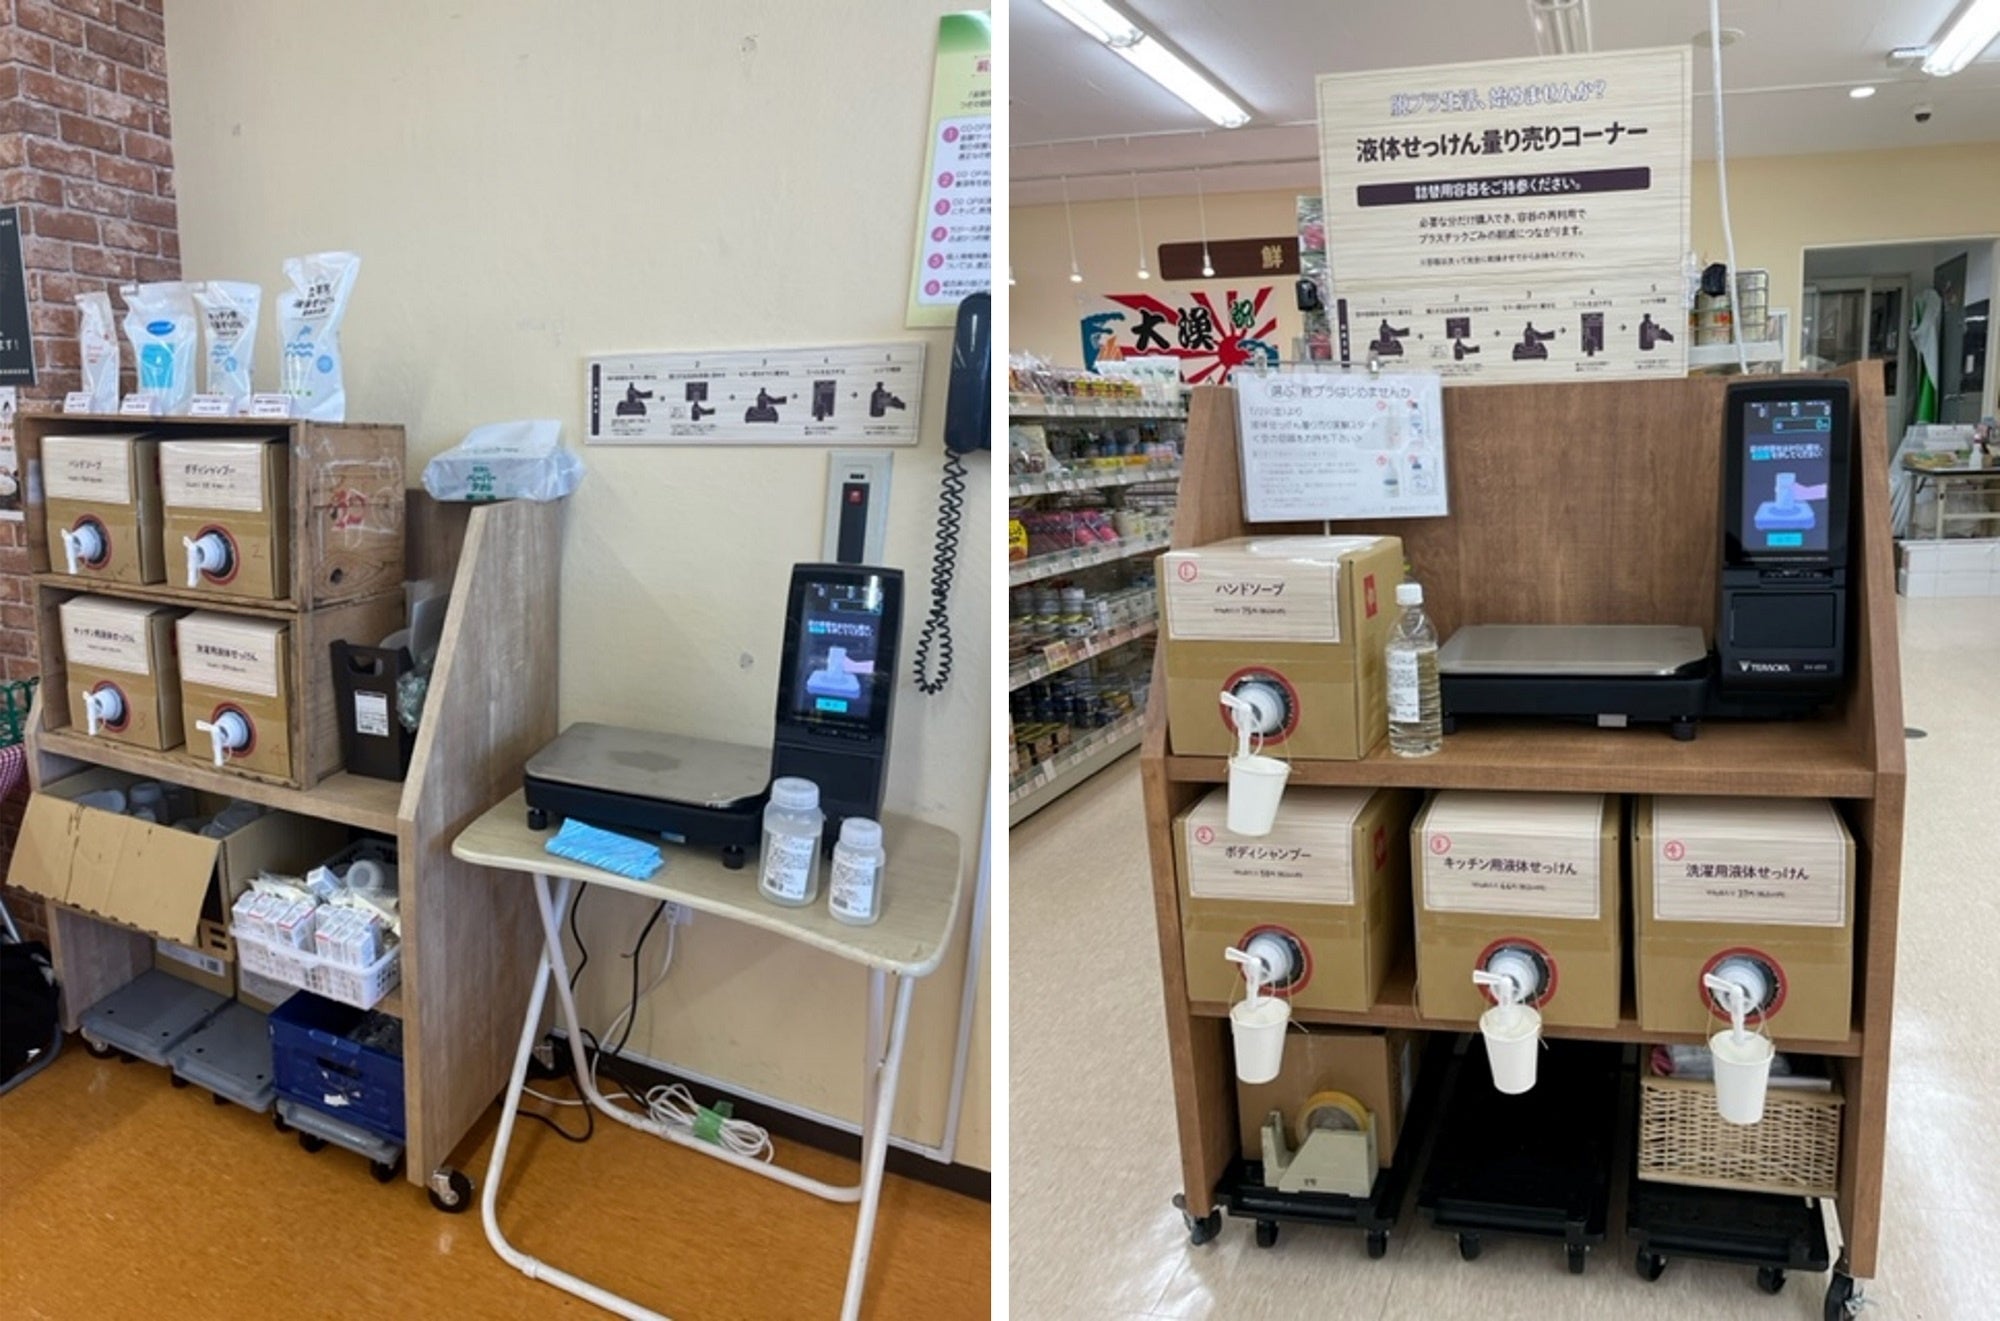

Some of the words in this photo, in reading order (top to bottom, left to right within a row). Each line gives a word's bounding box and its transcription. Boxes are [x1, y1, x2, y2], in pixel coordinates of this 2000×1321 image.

[1356, 121, 1649, 162] 液体せっけん量り売りコーナー
[1414, 177, 1582, 202] 詰替用容器をご持参ください。
[1419, 208, 1587, 229] 必要な分だけ購入でき、容器の再利用で
[1419, 226, 1584, 244] プラスチックごみの削減につながります。
[1261, 244, 1284, 269] 鮮
[1231, 299, 1256, 329] 祝
[1131, 306, 1215, 351] 大漁
[1215, 582, 1285, 596] ハンドソープ
[1225, 845, 1312, 862] ボディシャンプー
[1443, 857, 1578, 876] キッチン用液体せっけん
[1685, 863, 1810, 881] 洗濯用液体せっけん
